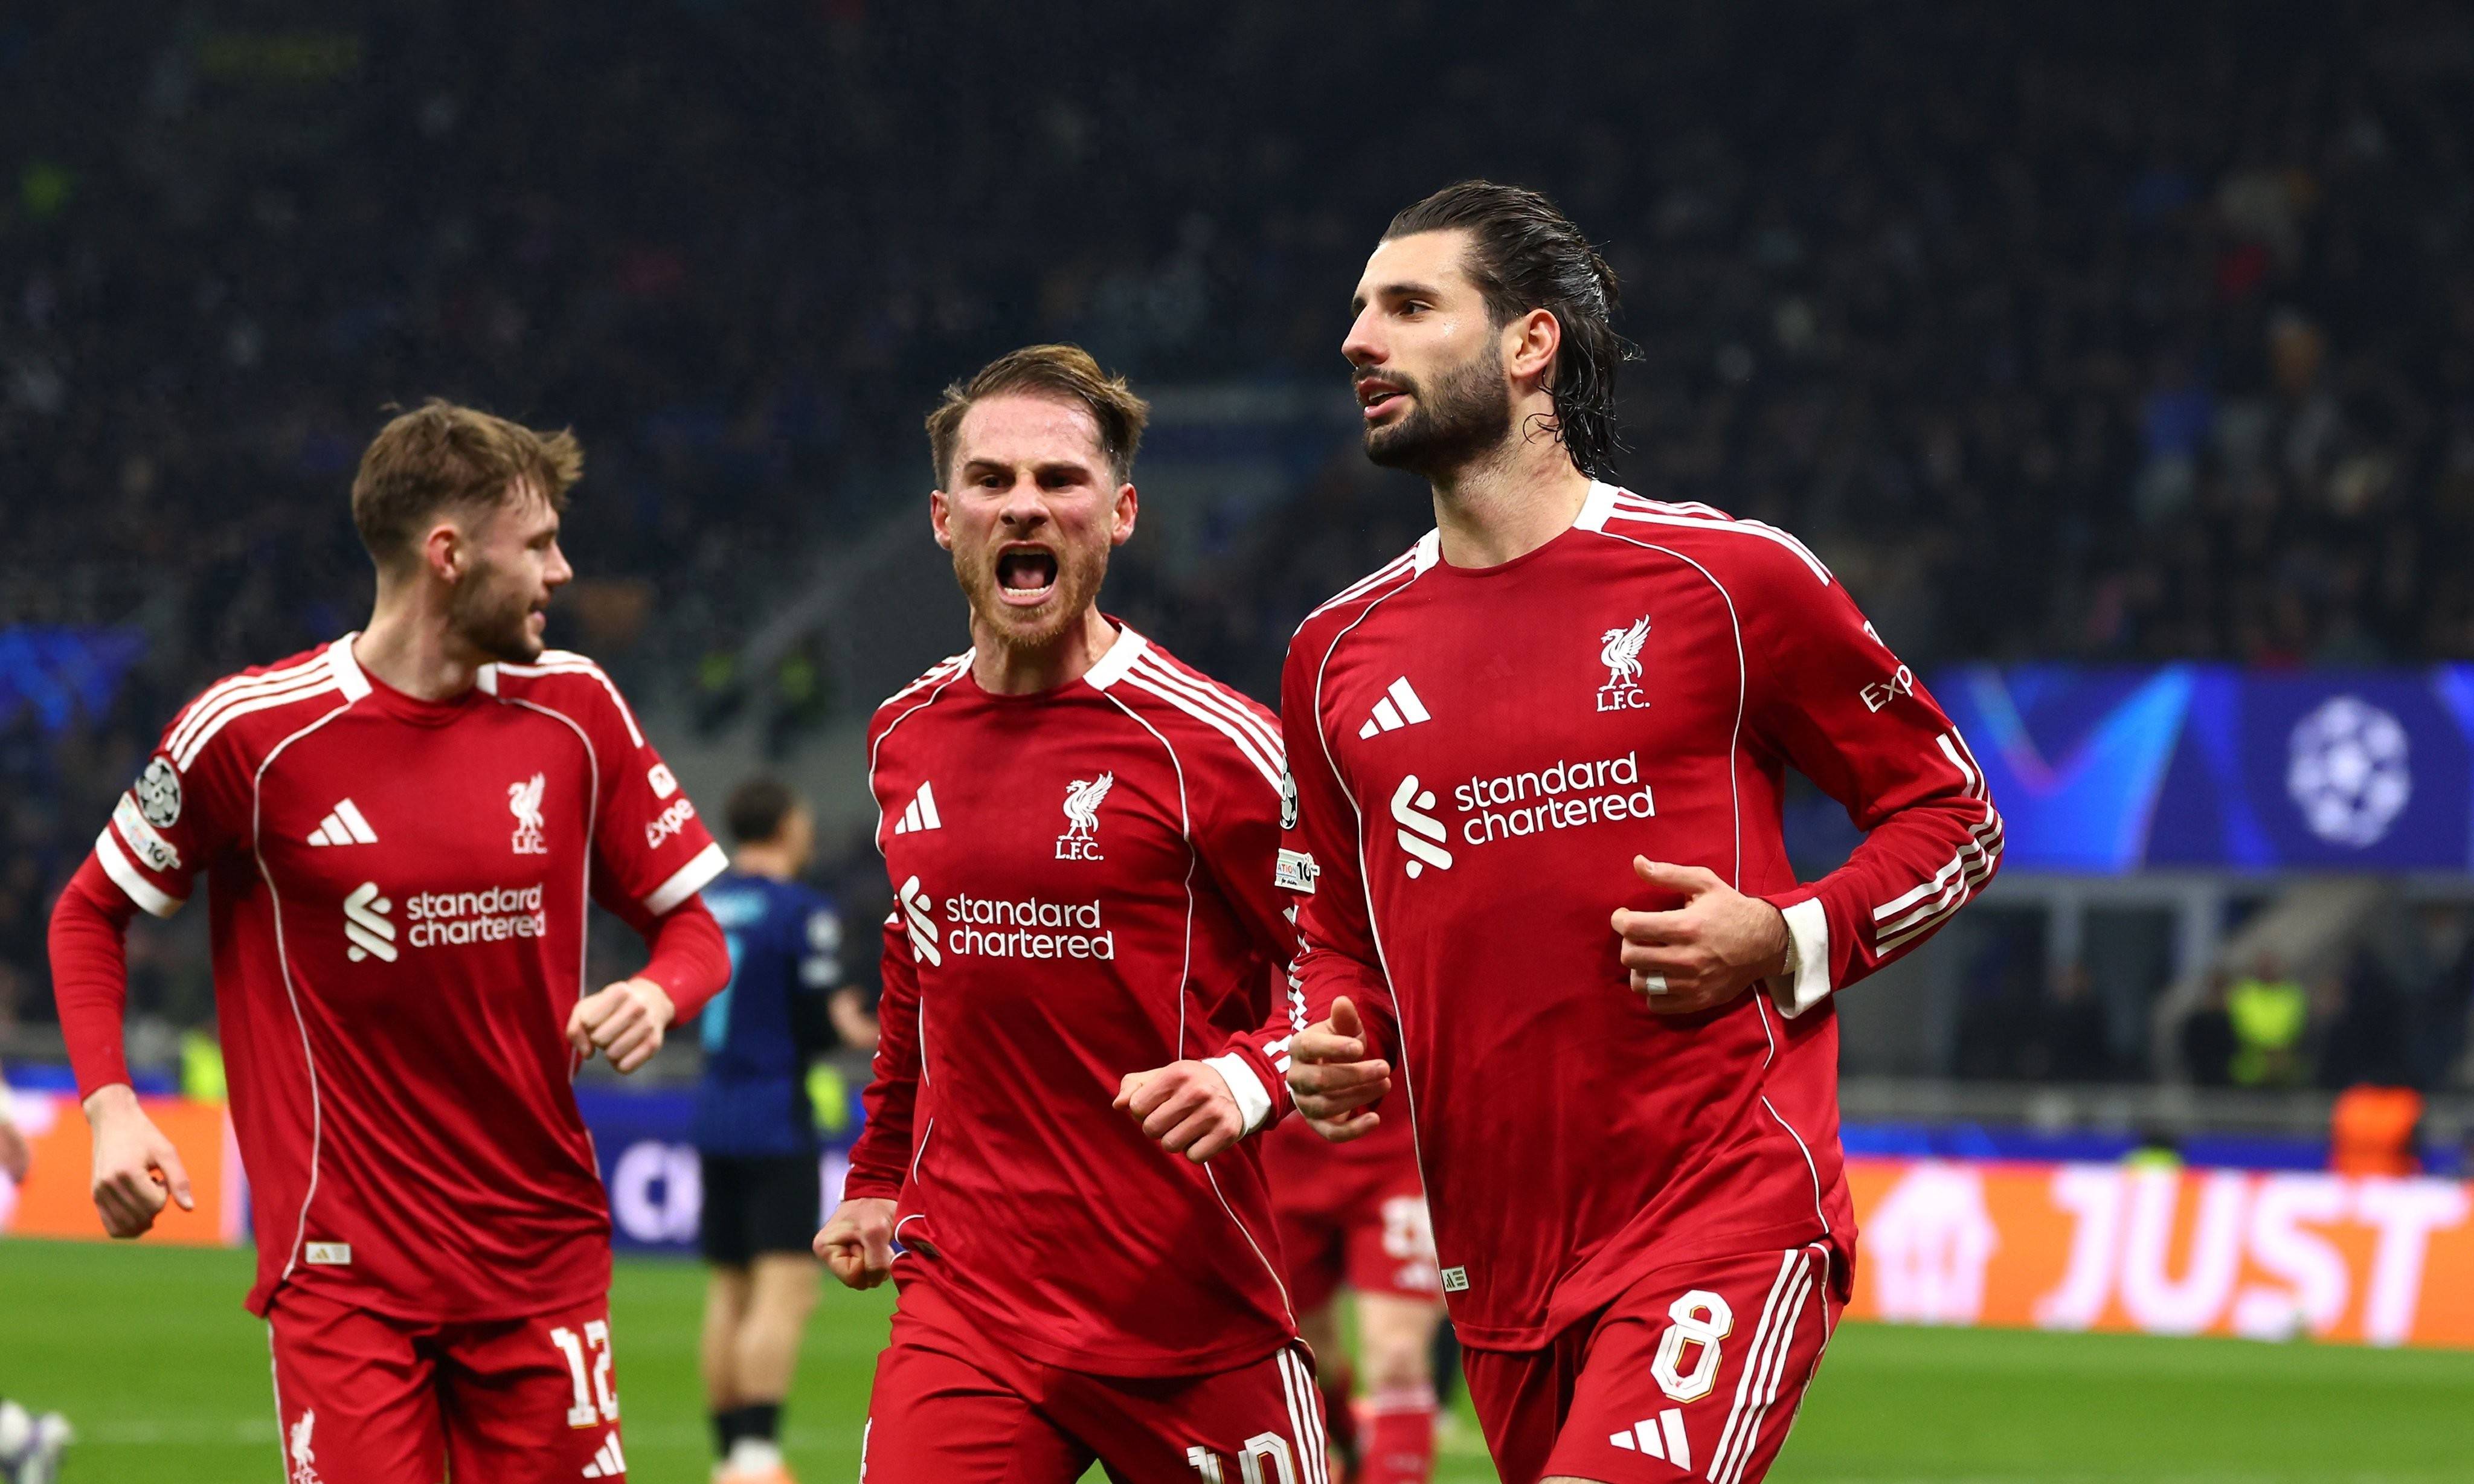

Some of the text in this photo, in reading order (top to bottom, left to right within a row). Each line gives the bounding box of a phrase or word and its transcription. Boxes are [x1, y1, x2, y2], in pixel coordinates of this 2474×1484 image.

[1596, 689, 1651, 712] L.F.C.
[1454, 750, 1638, 811] standard
[1464, 784, 1656, 845] chartered
[1055, 841, 1104, 861] L.F.C.
[1297, 861, 1311, 882] 10
[406, 882, 542, 920] standard
[945, 893, 1100, 928] standard
[409, 910, 546, 947] chartered
[949, 924, 1114, 960] chartered
[2032, 1163, 2470, 1347] JUST
[1650, 1290, 1735, 1404] 8
[550, 1320, 620, 1429] 12
